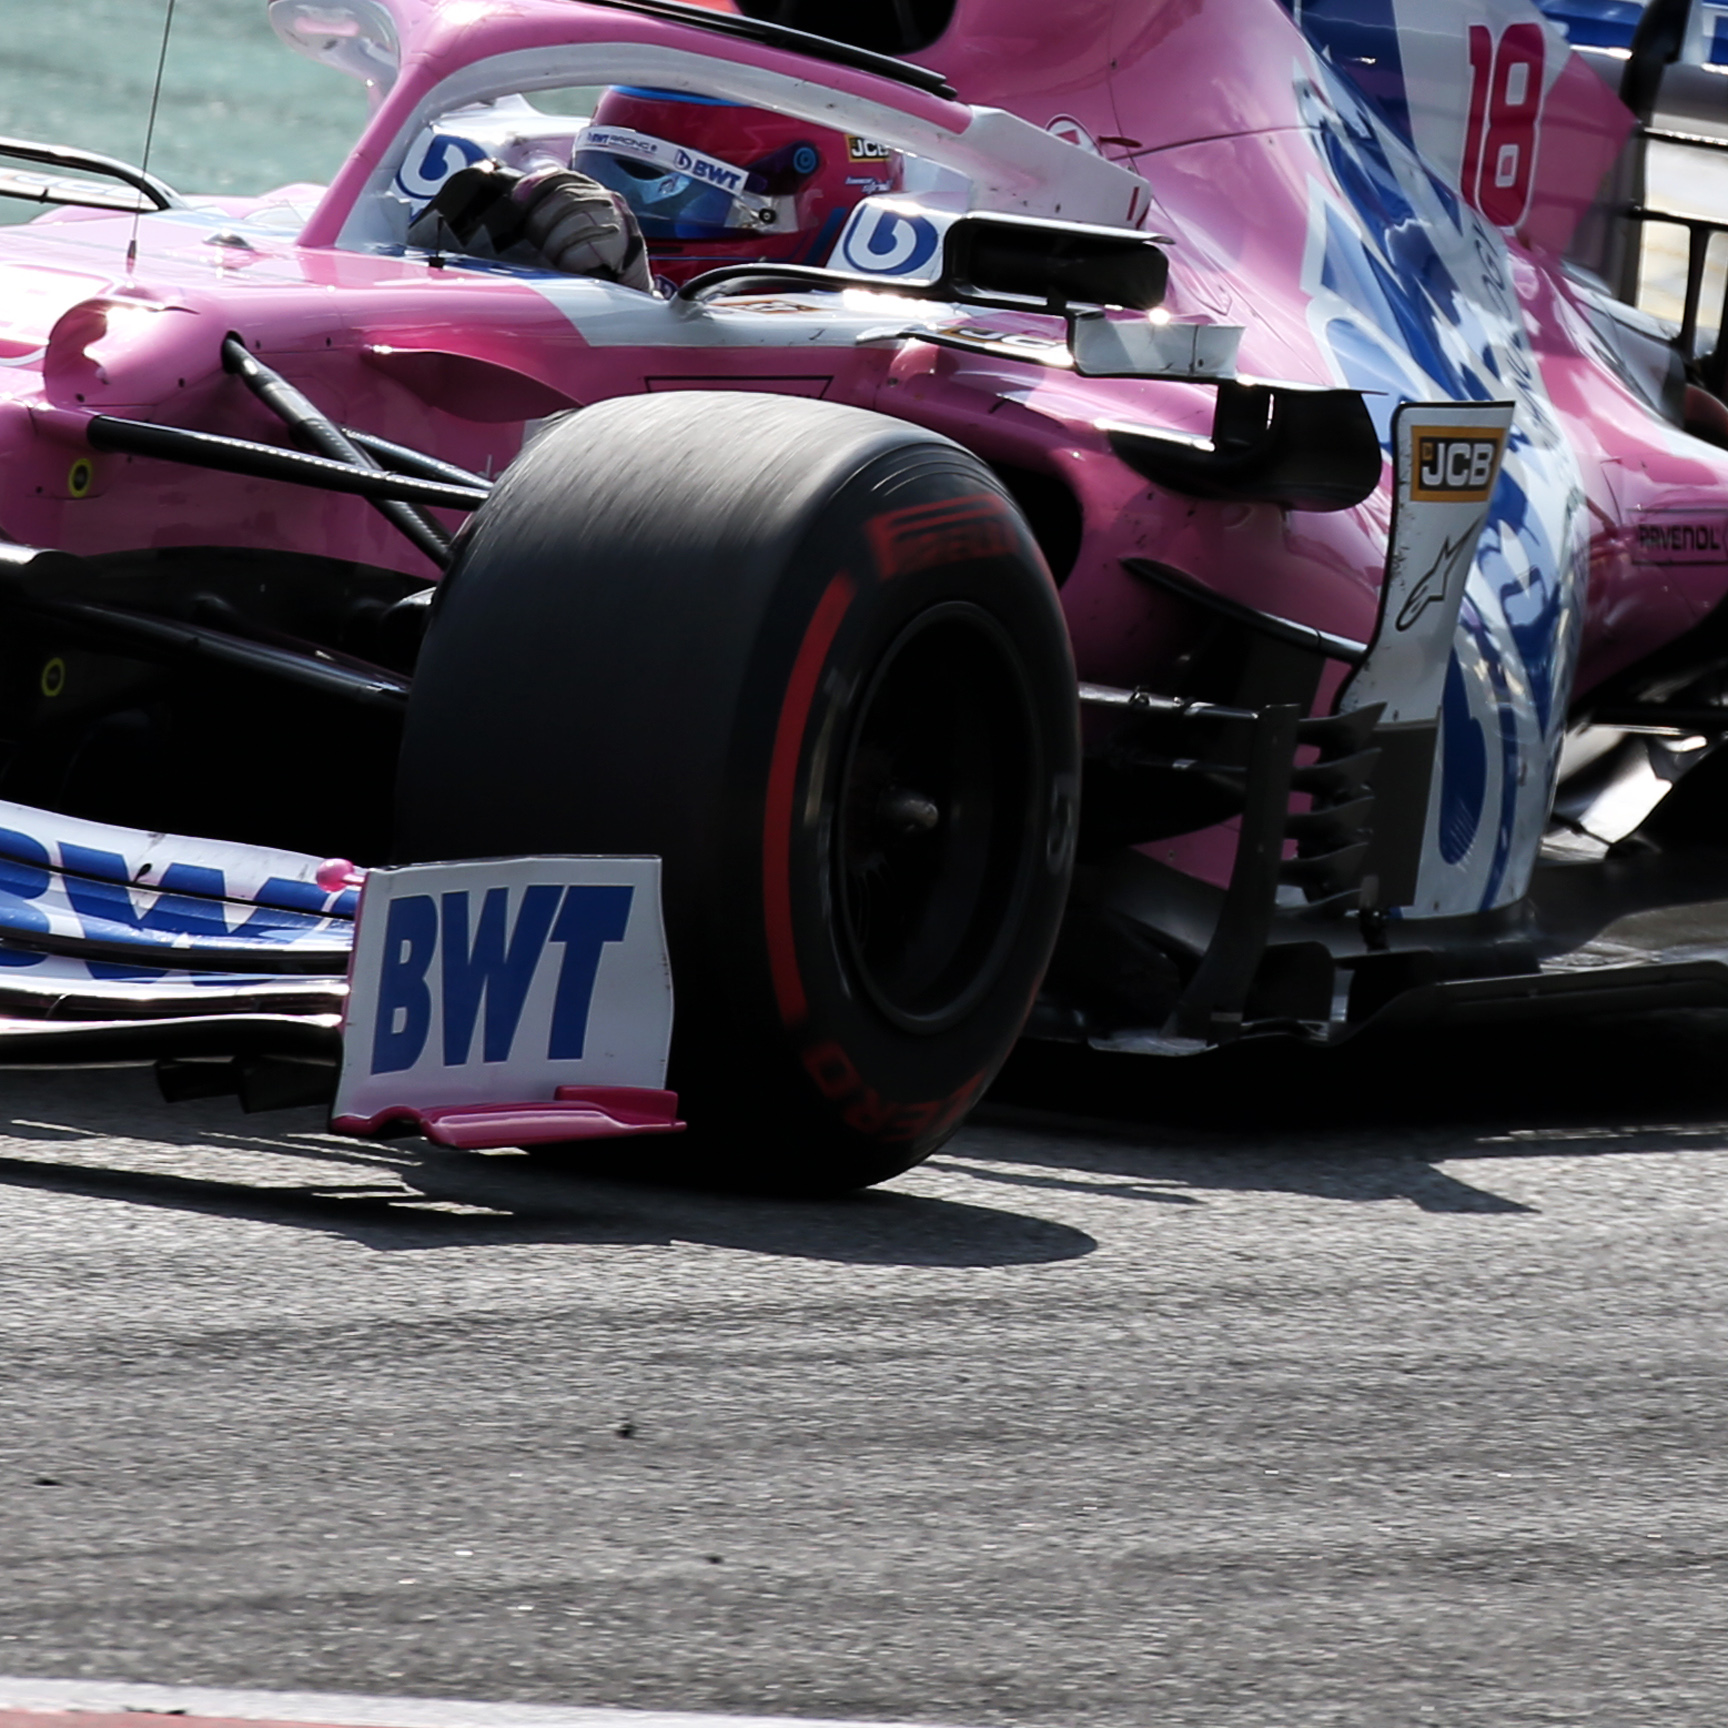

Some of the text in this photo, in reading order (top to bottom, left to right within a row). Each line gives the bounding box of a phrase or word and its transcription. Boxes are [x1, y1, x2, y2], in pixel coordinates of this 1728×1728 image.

[1458, 21, 1546, 229] 18
[691, 159, 741, 190] BWT
[1421, 441, 1495, 488] JCB
[1637, 521, 1720, 553] RAVENOL
[371, 885, 634, 1075] BWT
